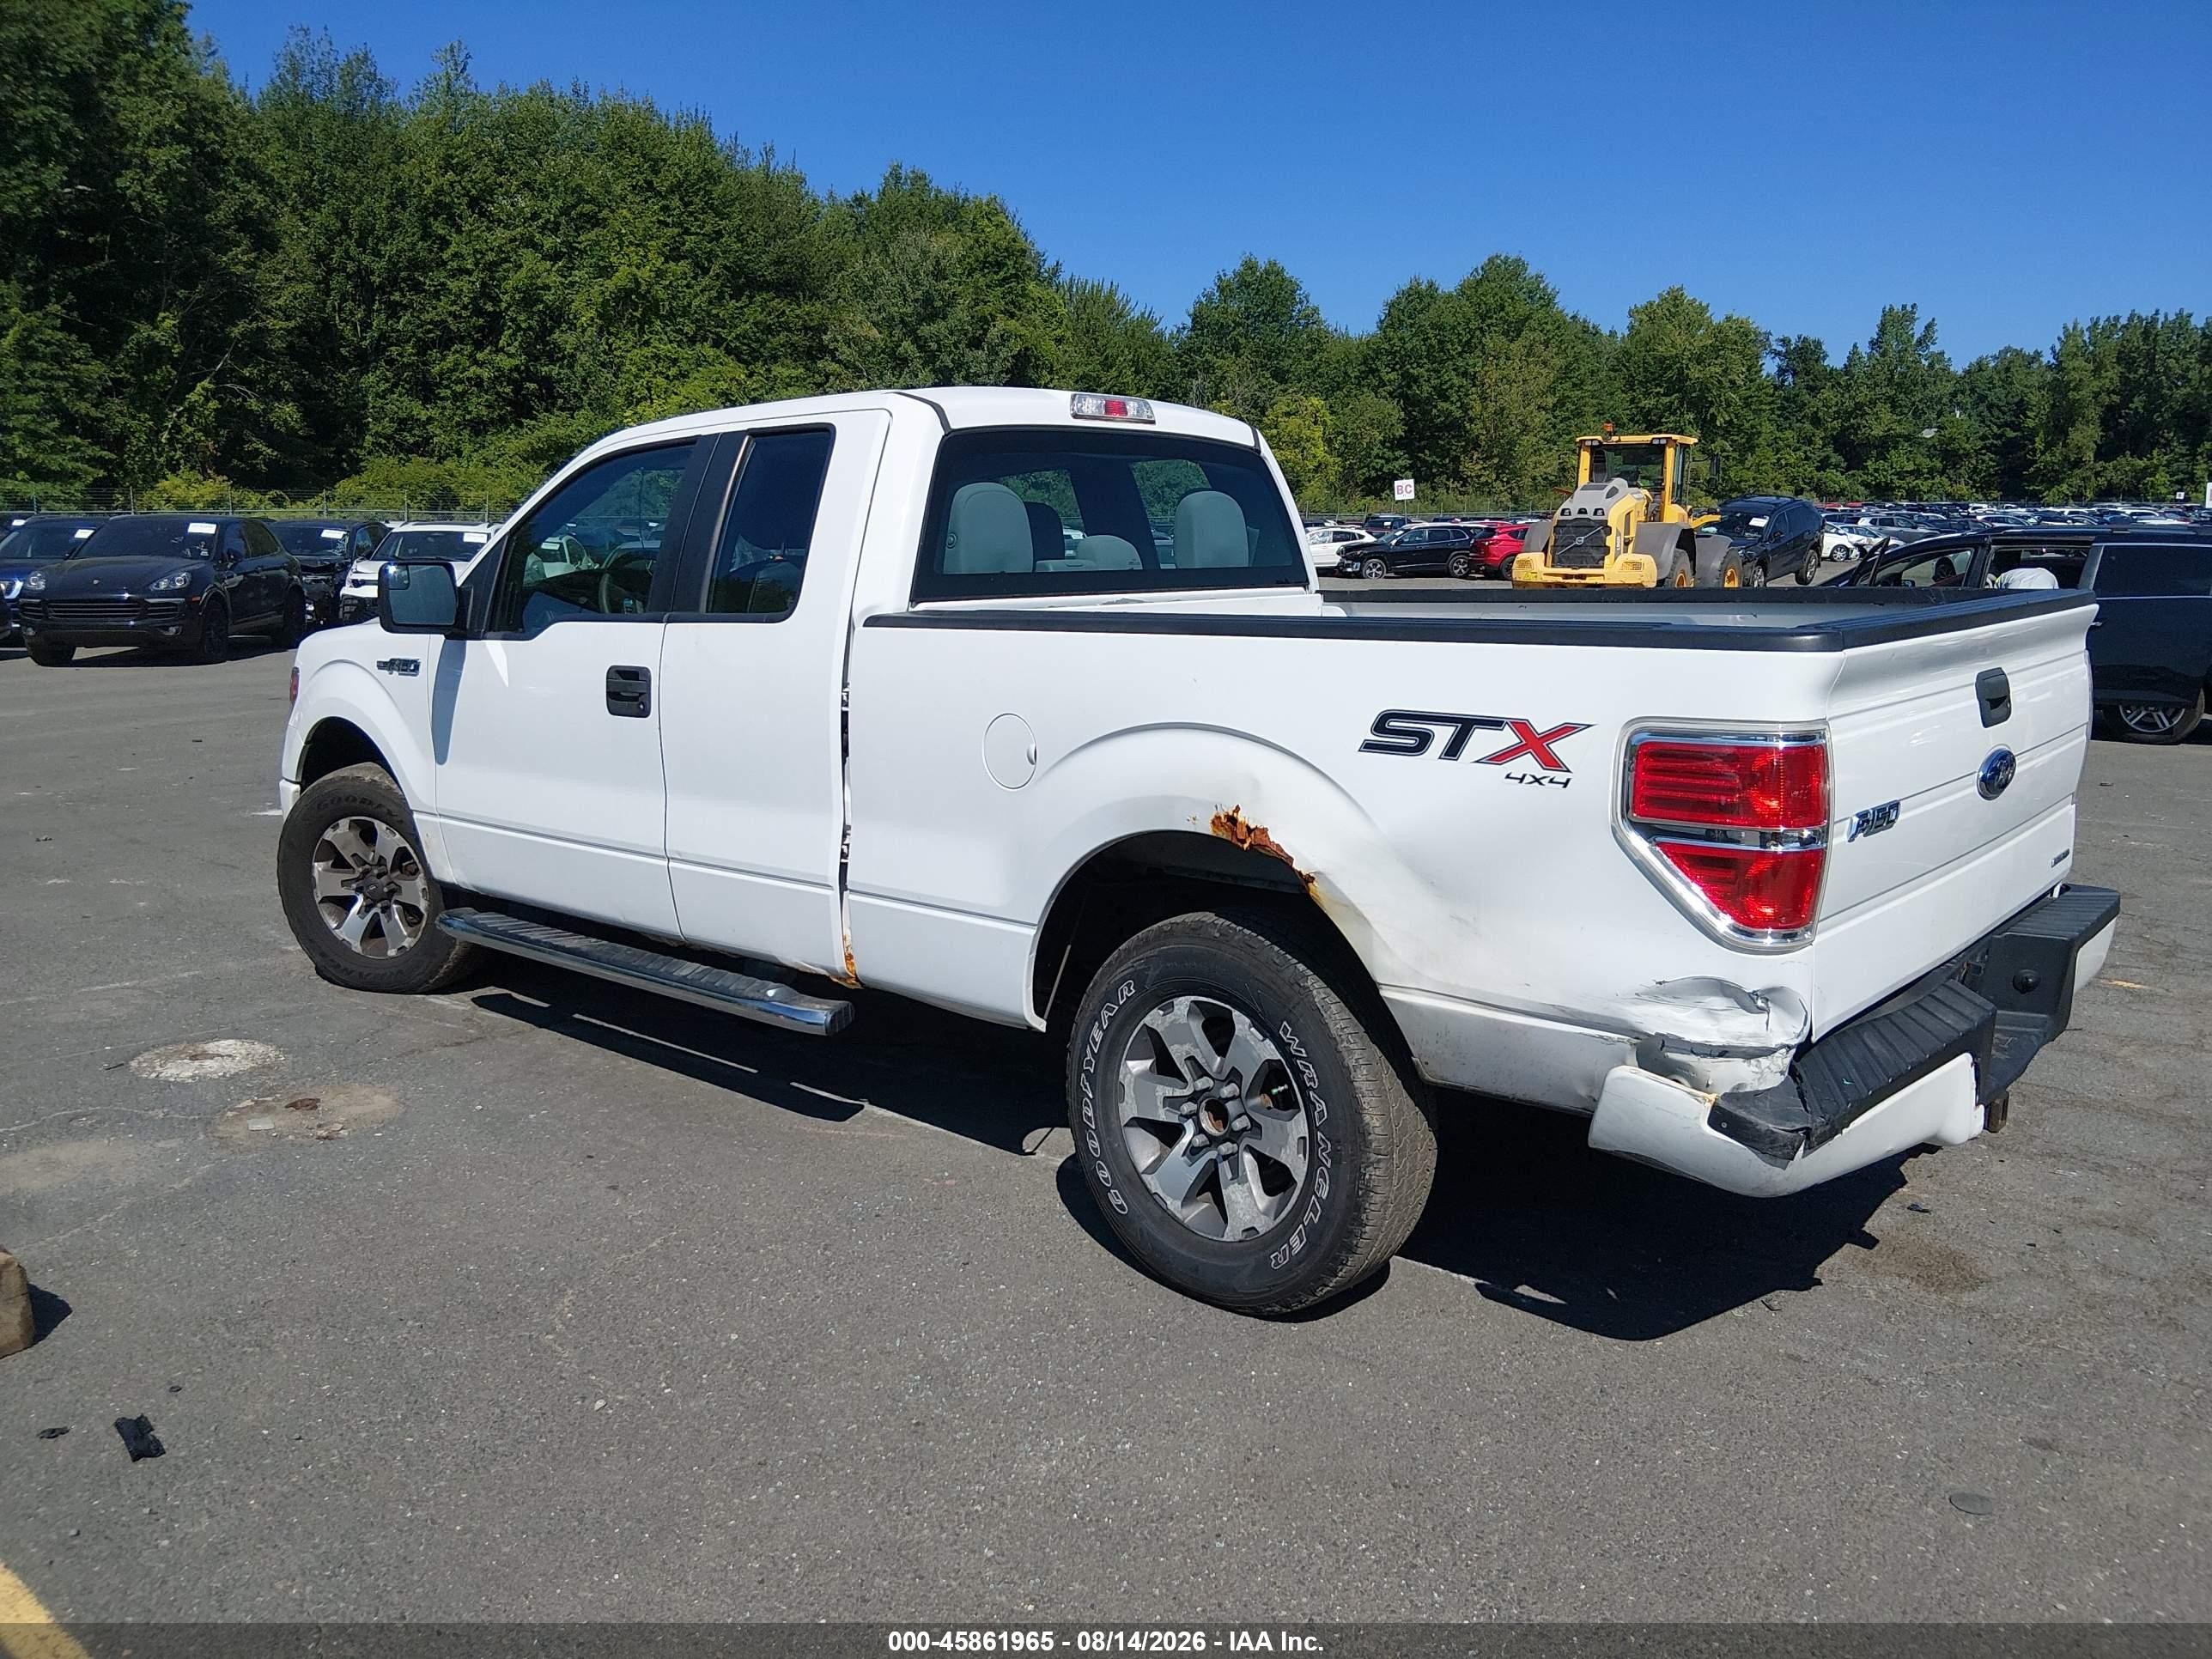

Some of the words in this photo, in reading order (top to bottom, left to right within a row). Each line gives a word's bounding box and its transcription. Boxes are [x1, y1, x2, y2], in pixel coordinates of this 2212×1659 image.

[1396, 483, 1413, 495] BC
[1357, 708, 1599, 773] STX
[1078, 979, 1136, 1215] GOODYEAR
[1269, 1020, 1333, 1270] WRANGLER
